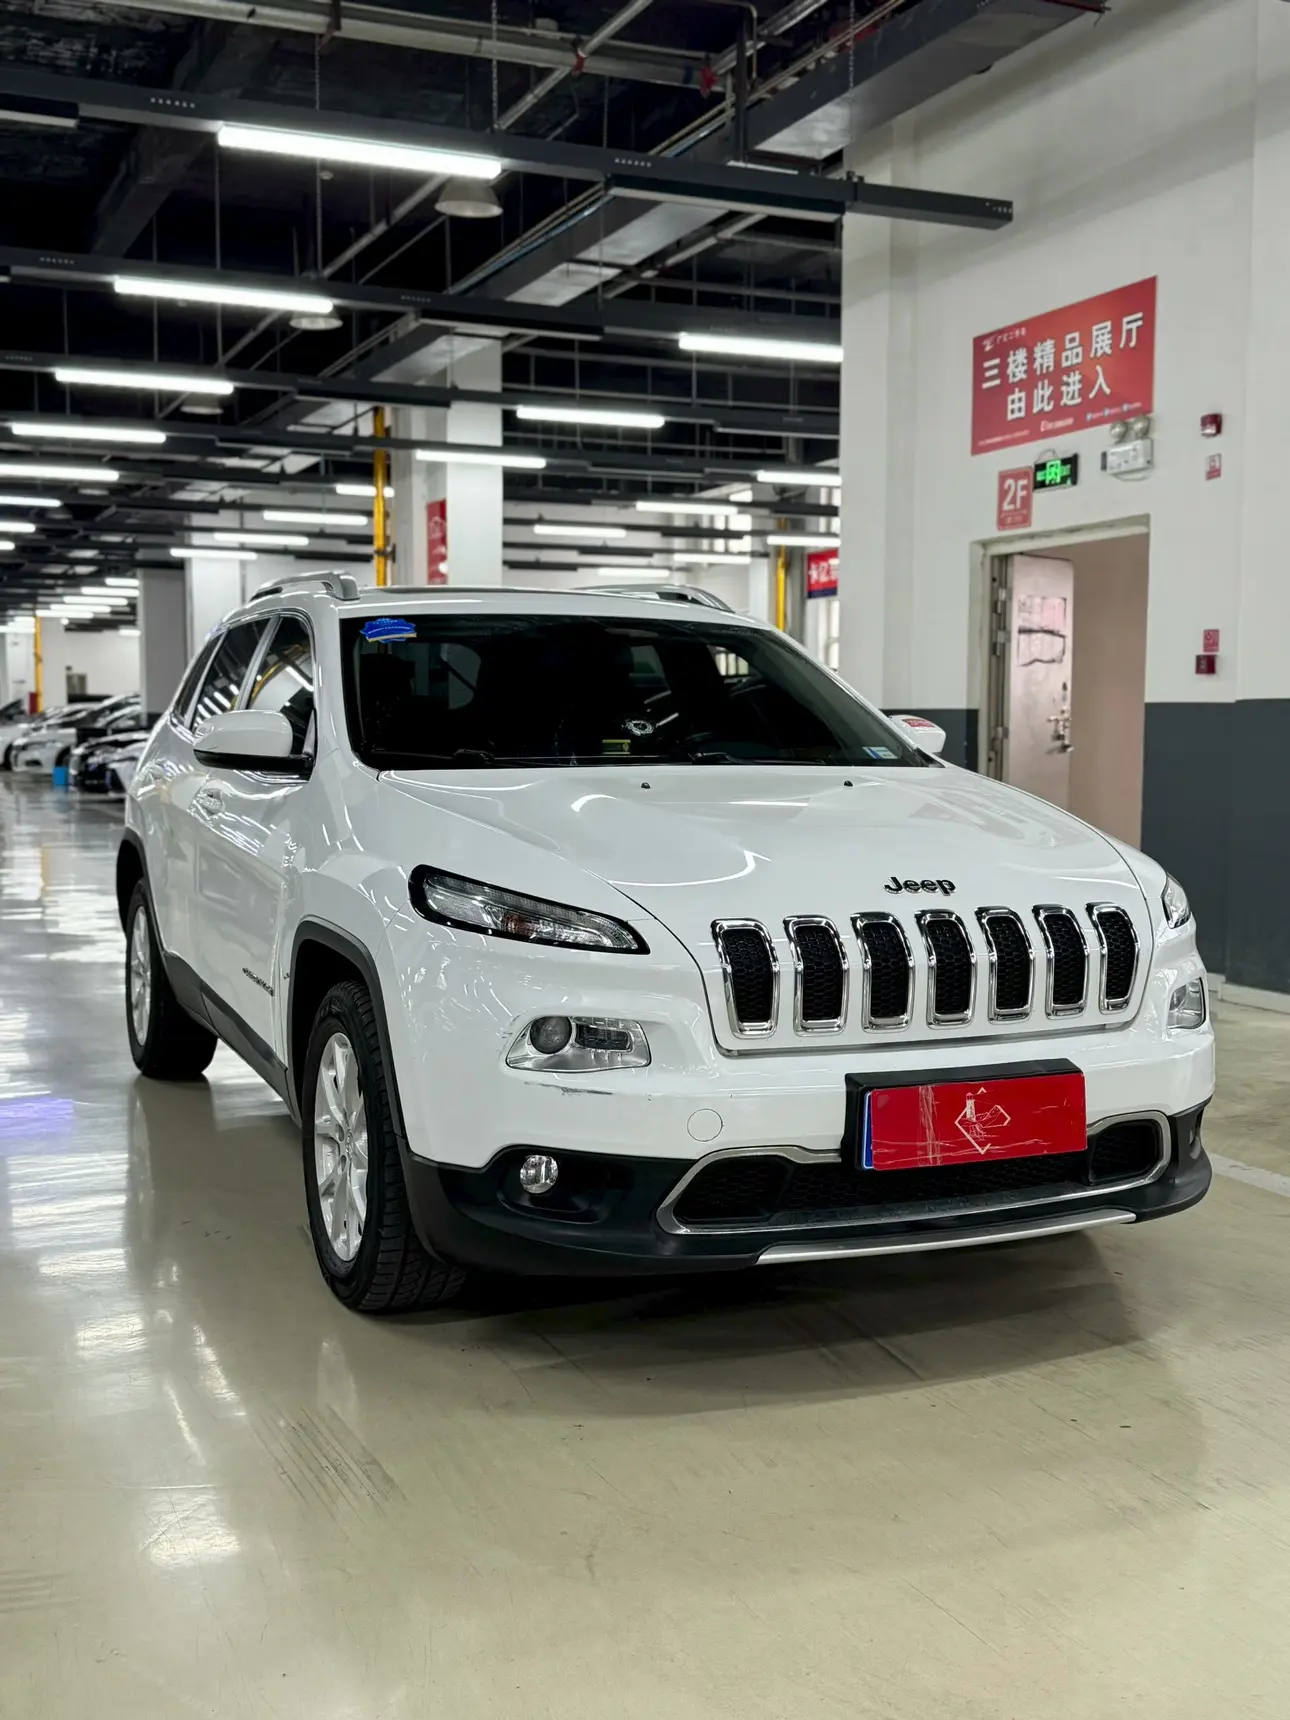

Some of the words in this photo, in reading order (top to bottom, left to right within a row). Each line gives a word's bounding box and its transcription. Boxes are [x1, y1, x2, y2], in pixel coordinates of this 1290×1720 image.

[982, 312, 1144, 389] 三楼精品展厅
[1007, 364, 1111, 421] 由此进入
[1002, 478, 1028, 511] 2F
[883, 876, 956, 896] Jeep
